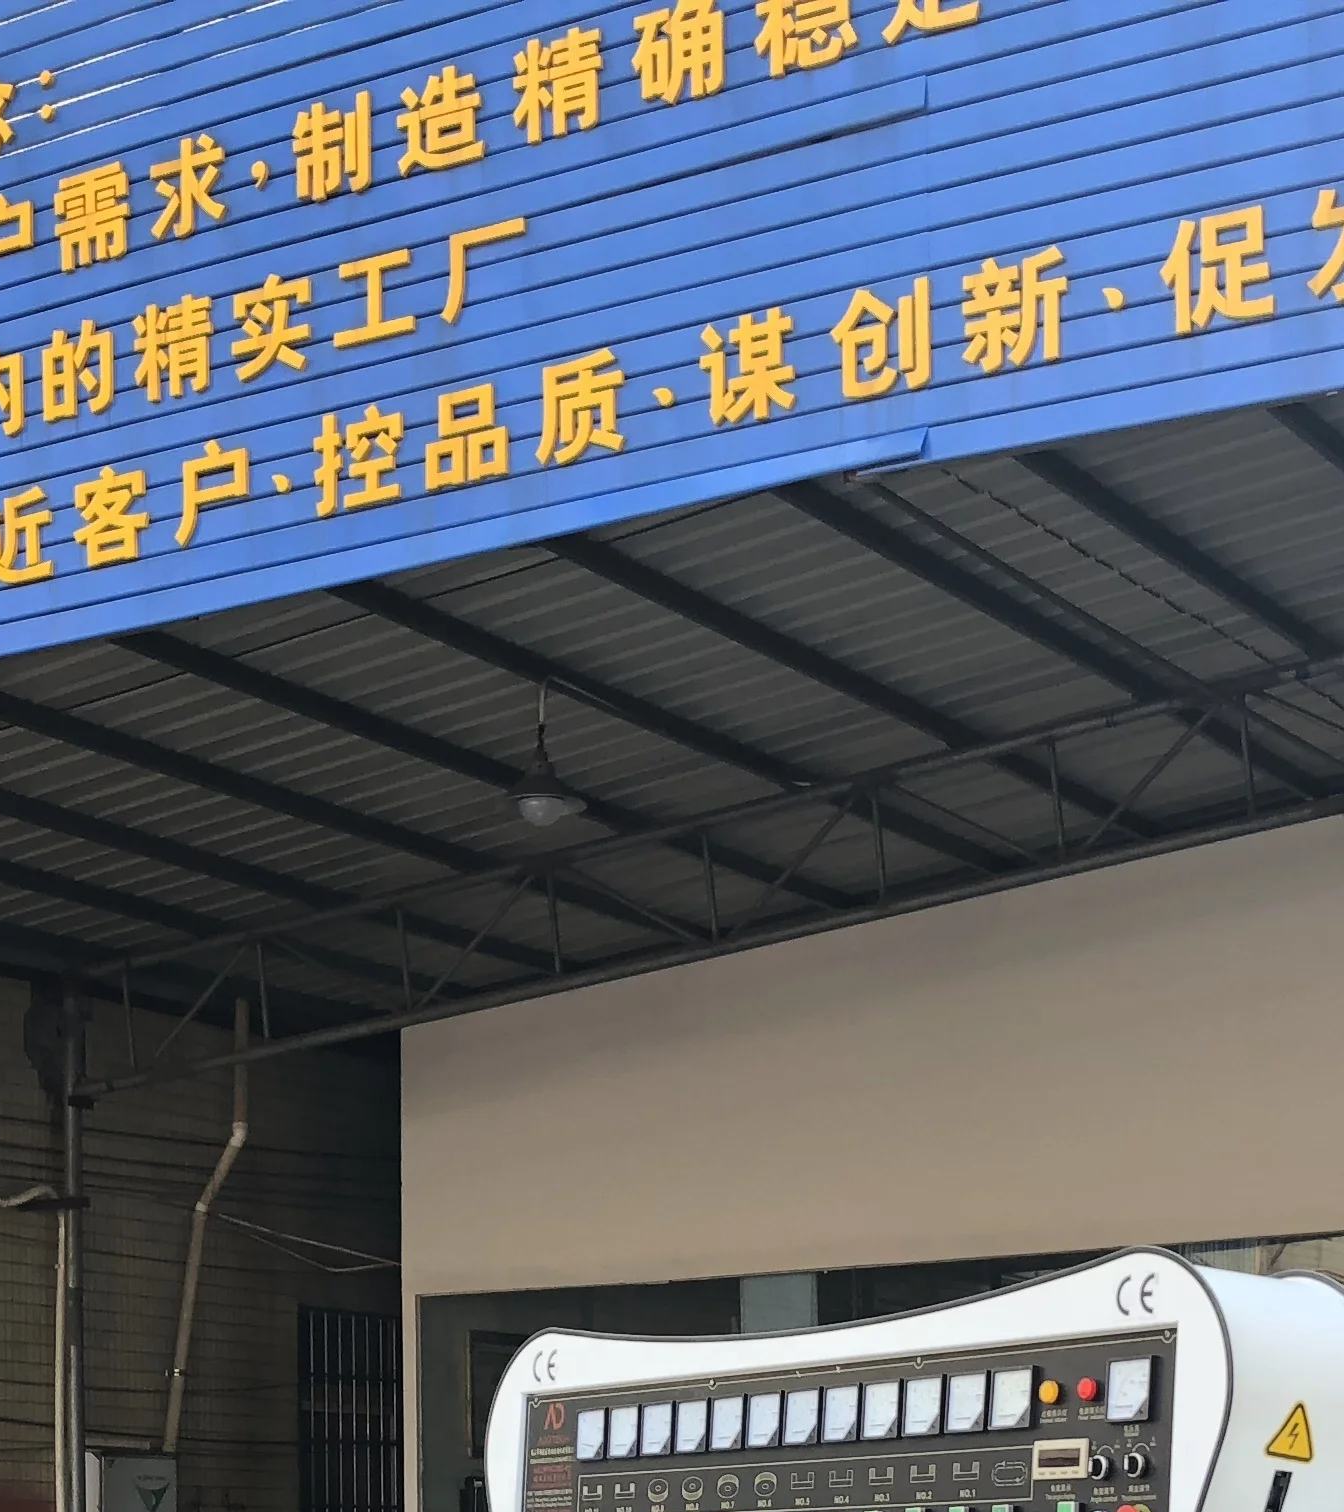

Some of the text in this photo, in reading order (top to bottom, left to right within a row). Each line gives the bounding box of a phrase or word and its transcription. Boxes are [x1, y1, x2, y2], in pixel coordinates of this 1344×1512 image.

[1117, 1272, 1156, 1316] CE
[532, 1350, 558, 1383] CE
[916, 1490, 933, 1500] NO.2
[959, 1488, 976, 1499] NO.1
